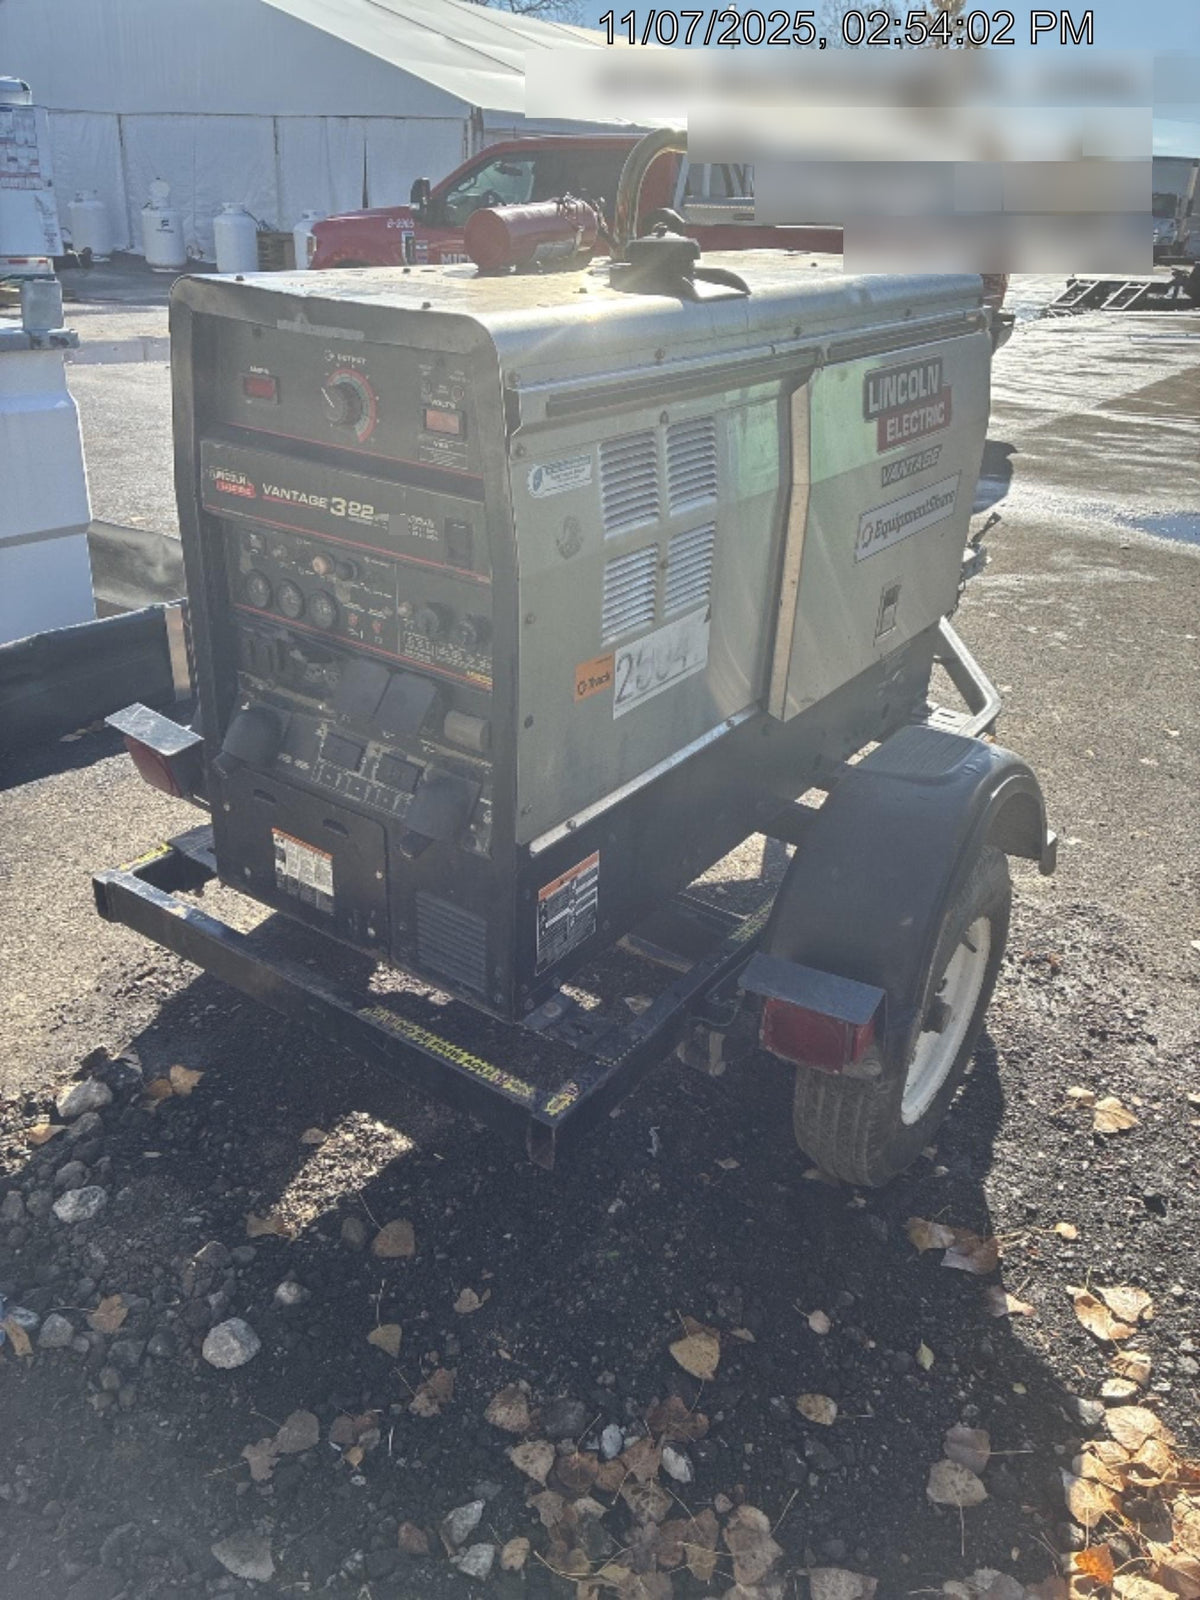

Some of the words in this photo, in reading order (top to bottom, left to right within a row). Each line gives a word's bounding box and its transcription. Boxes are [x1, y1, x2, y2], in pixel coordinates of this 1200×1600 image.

[865, 364, 941, 414] LINCOLN
[886, 400, 946, 442] ELECTRIC
[882, 447, 941, 487] VANTAGE
[262, 482, 328, 510] VANTAGE
[330, 496, 375, 520] 322
[874, 489, 956, 541] EquipmentShare
